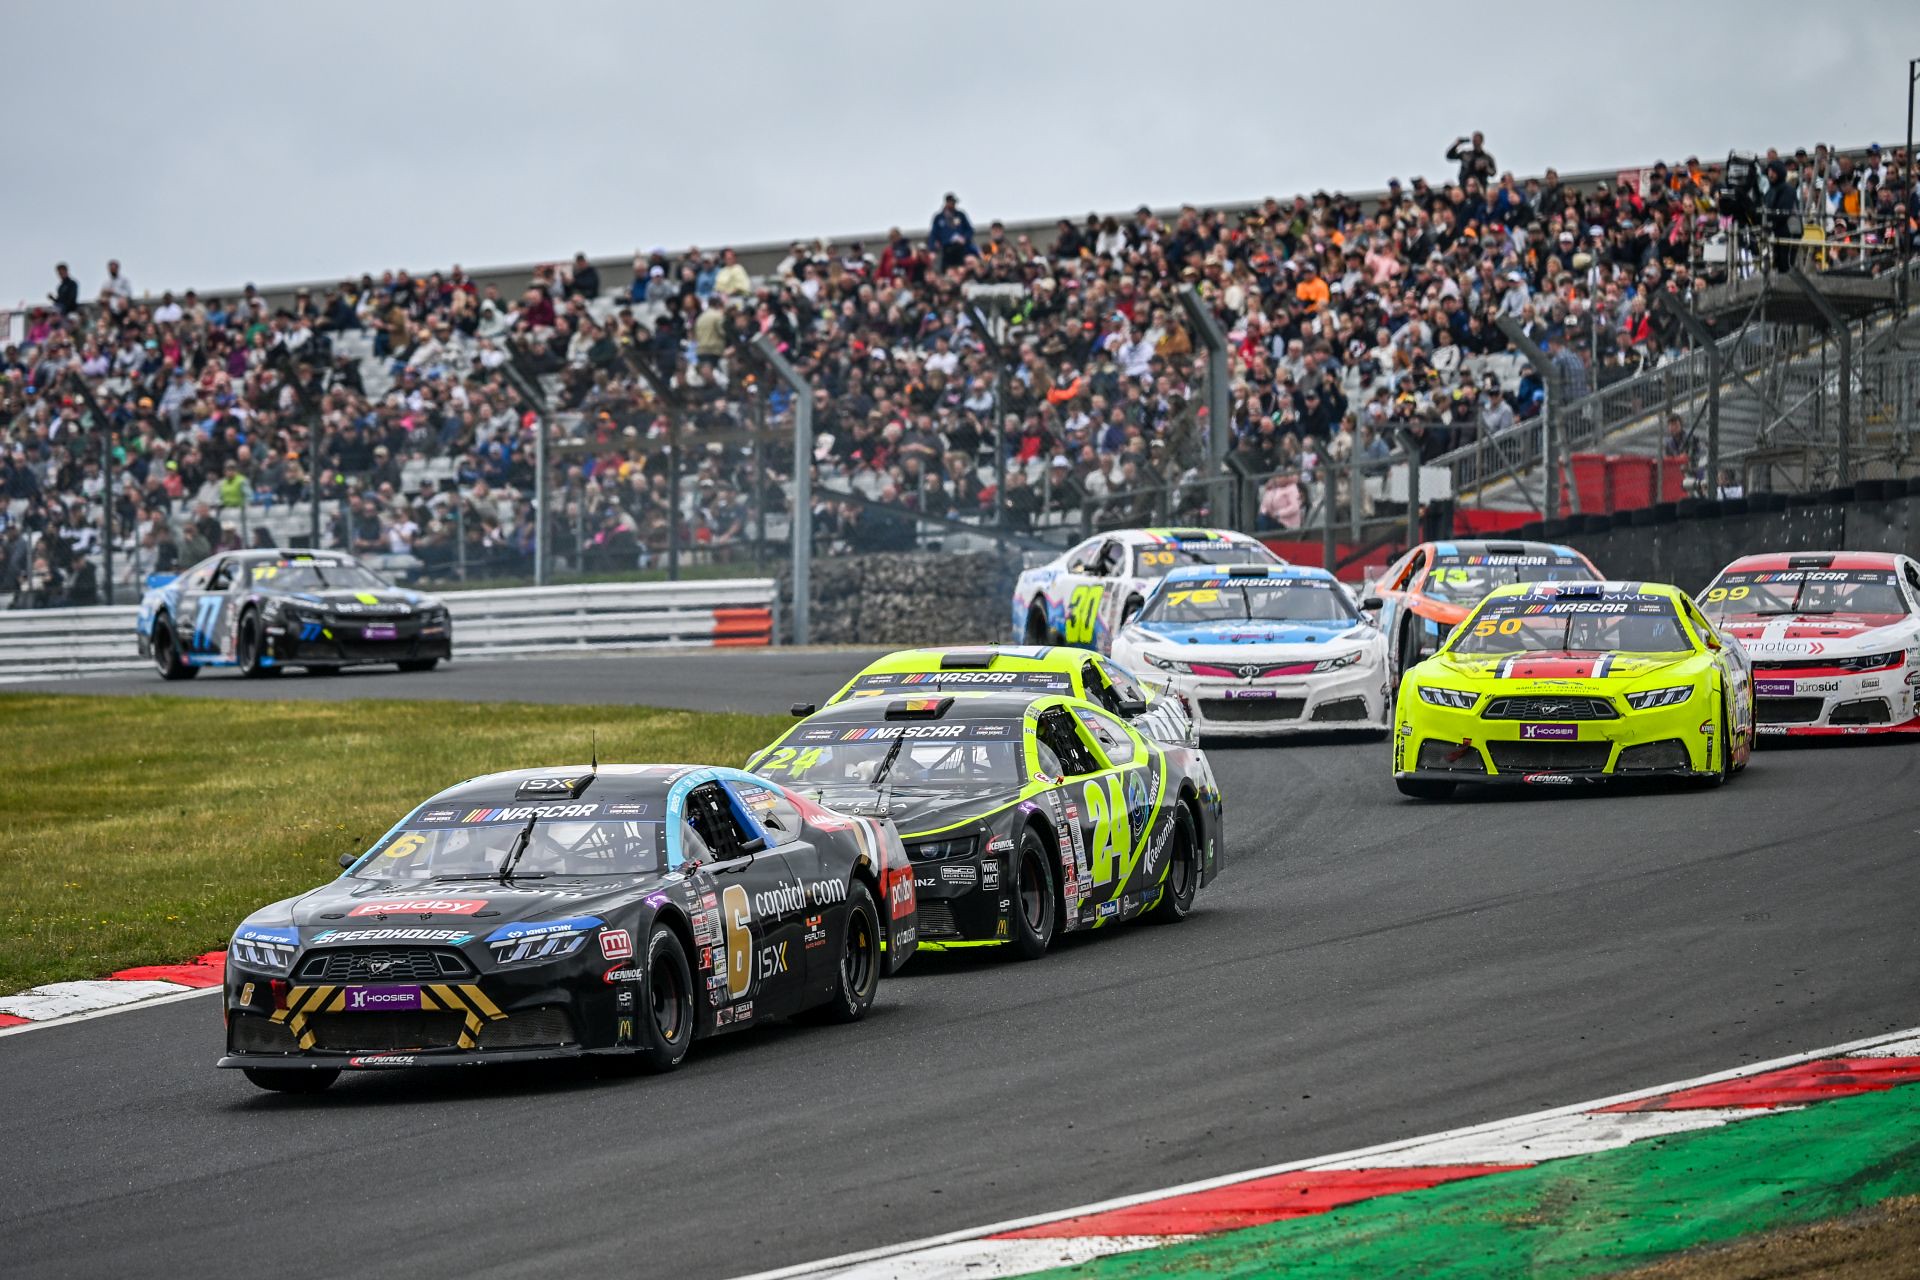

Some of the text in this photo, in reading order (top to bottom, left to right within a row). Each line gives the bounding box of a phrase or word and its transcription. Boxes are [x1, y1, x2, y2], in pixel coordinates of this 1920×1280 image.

[1140, 551, 1175, 566] 30
[1488, 556, 1547, 565] NASCAR
[1429, 568, 1468, 583] 13
[1776, 572, 1849, 582] NASCAR
[1225, 578, 1292, 588] NASCAR
[1707, 586, 1750, 602] 99
[1065, 584, 1105, 644] 30
[1549, 603, 1628, 613] NASCAR
[193, 596, 224, 649] 77
[1474, 618, 1522, 637] 50
[300, 623, 322, 640] 77
[932, 672, 1017, 684] NASCAR
[1796, 682, 1838, 692] bürosüd
[869, 726, 966, 739] NASCAR
[763, 749, 825, 774] 24
[519, 778, 578, 790] ISX
[1149, 770, 1160, 808] SERVICE
[494, 803, 600, 821] NASCAR
[1084, 774, 1132, 887] 24
[384, 835, 427, 859] 6
[989, 840, 1014, 850] KENNOL
[982, 862, 998, 873] WRK
[984, 874, 998, 884] MKT
[358, 900, 473, 914] paidby
[314, 928, 470, 945] SPEEDHOUSE
[526, 924, 572, 936] KING TONY
[723, 884, 752, 1000] 6
[758, 940, 788, 980] ISX
[606, 968, 643, 981] KENNOL
[240, 982, 255, 1006] 6
[367, 994, 414, 1002] HOOSIER
[355, 1056, 416, 1064] KENNOL
